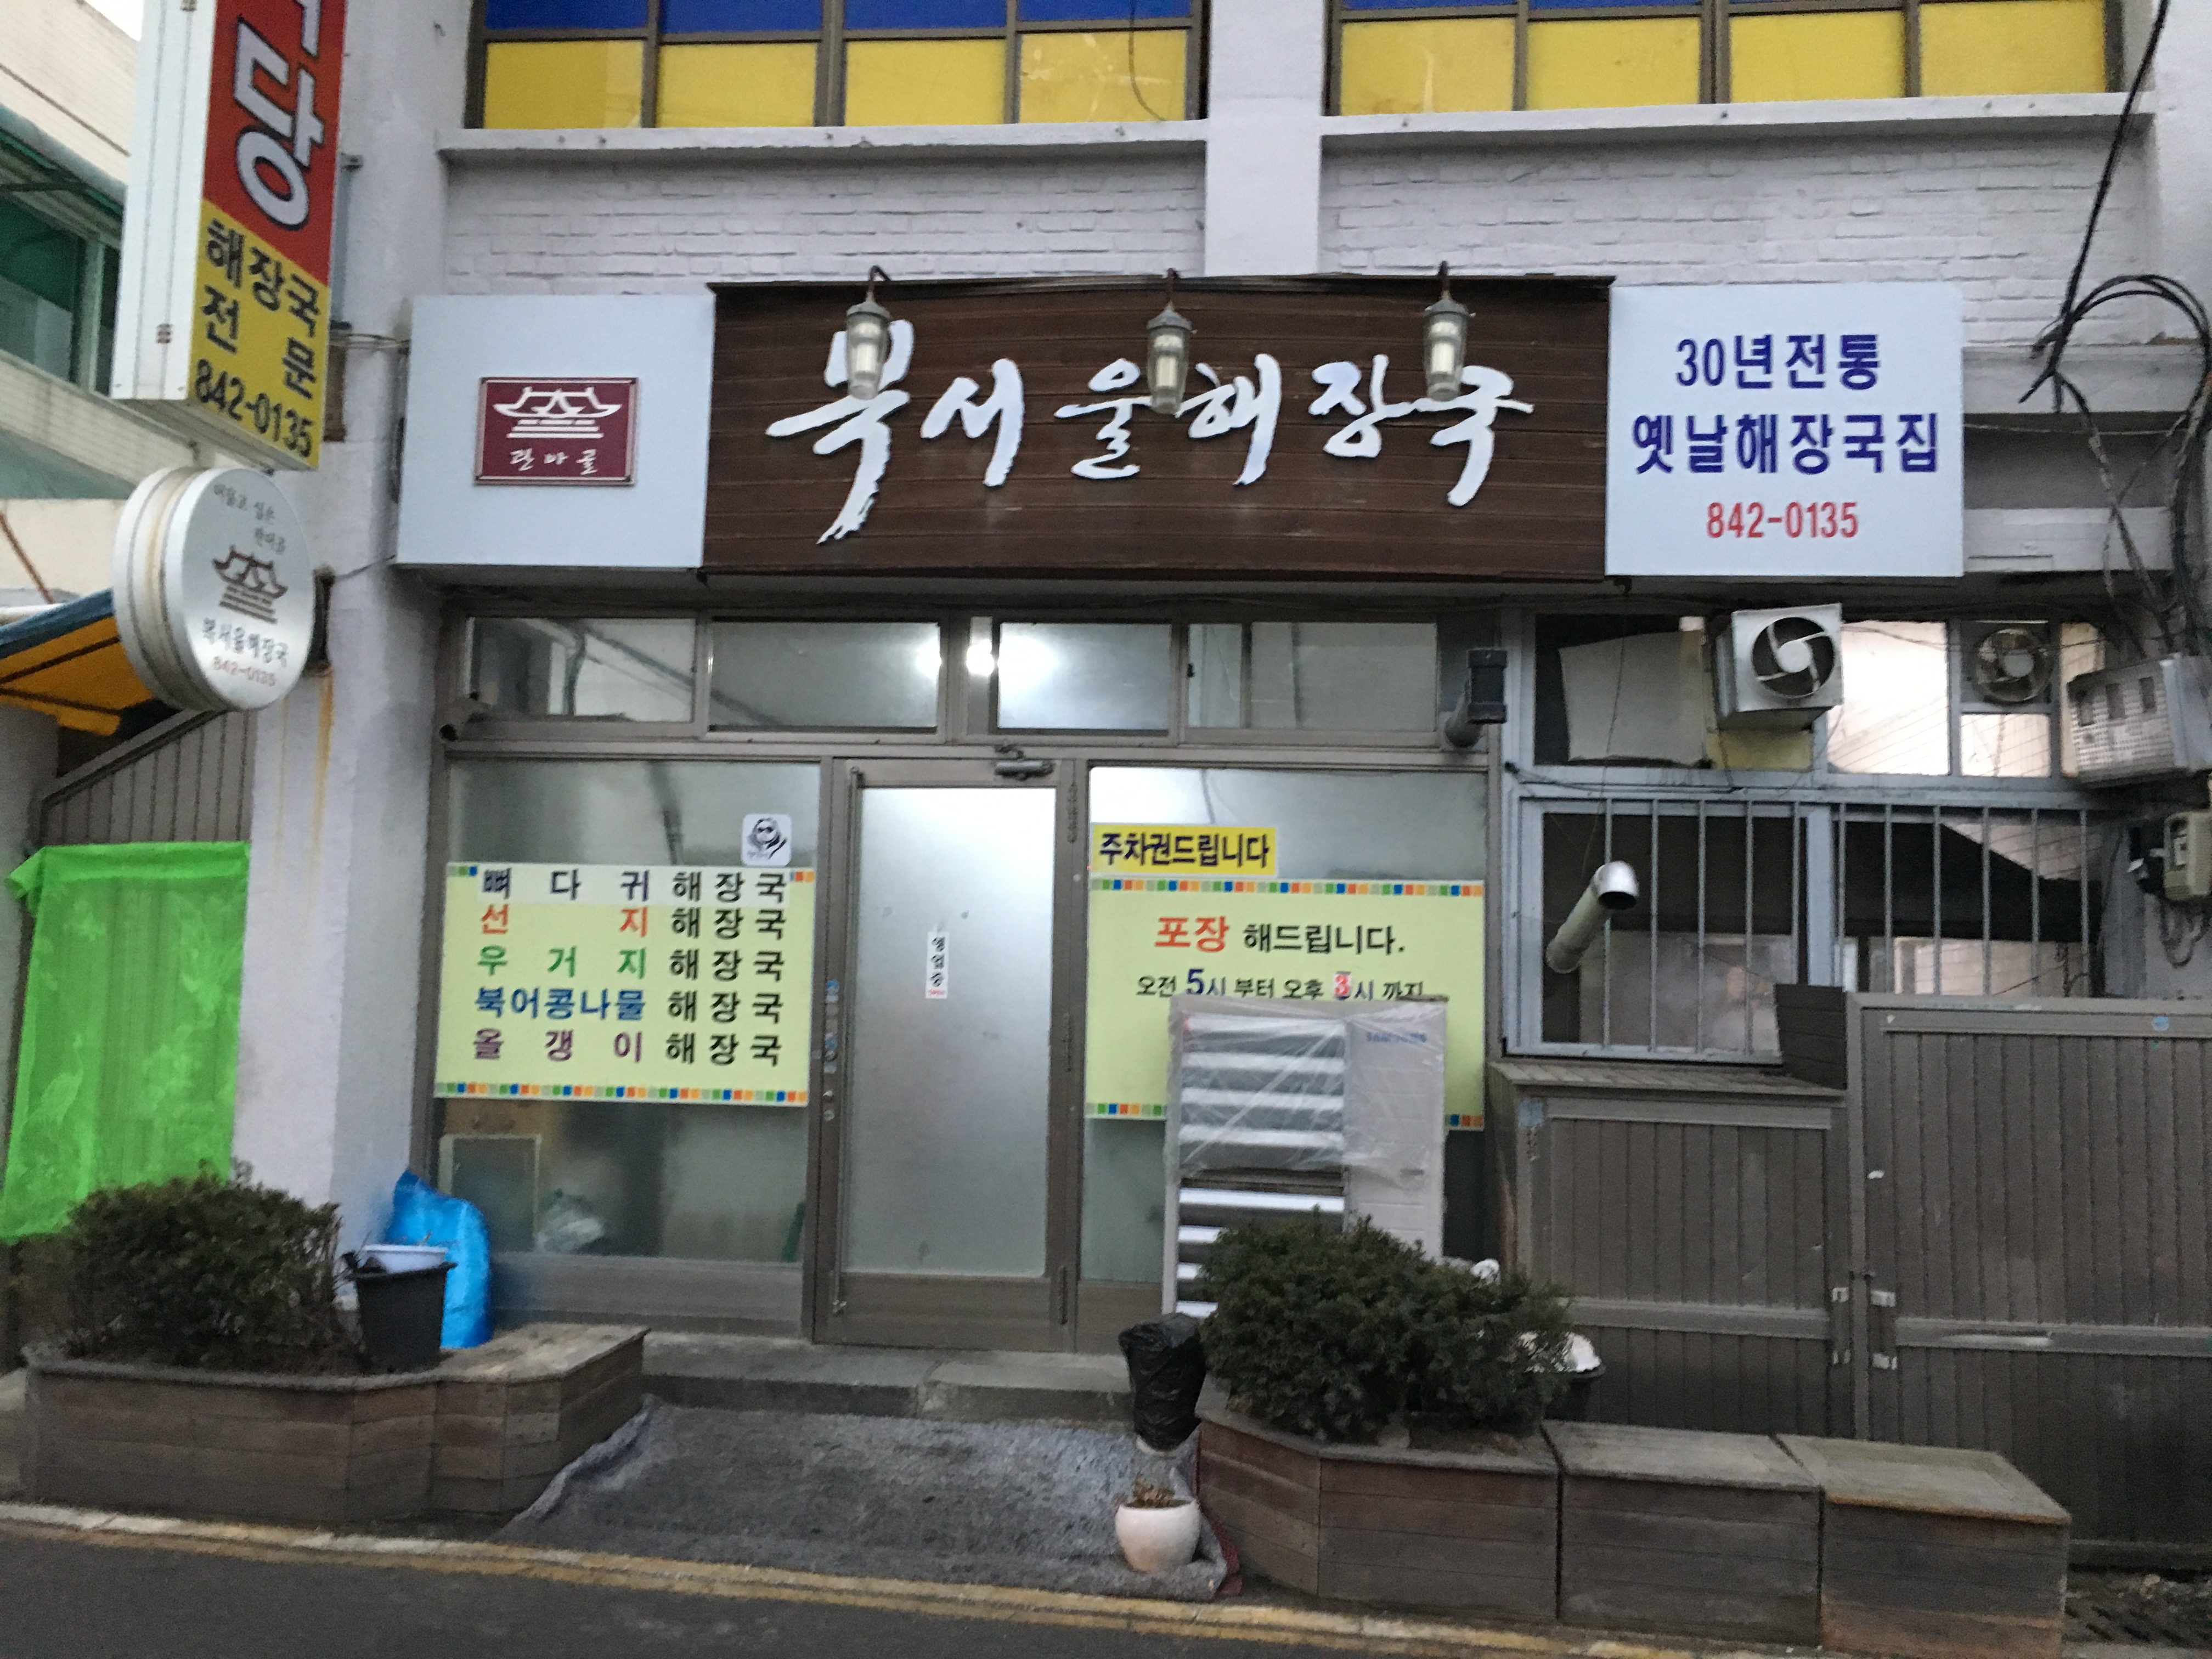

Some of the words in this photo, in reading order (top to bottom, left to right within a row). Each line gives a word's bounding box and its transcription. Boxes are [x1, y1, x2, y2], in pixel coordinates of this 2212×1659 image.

[205, 219, 322, 338] 해장국
[194, 359, 314, 458] 842-0135
[766, 320, 1534, 545] 북서울해장국
[1707, 501, 1859, 539] 842-0135
[1099, 832, 1269, 868] 주차권드립니다
[672, 871, 787, 903] 해장국
[671, 907, 786, 940] 해장국
[1154, 916, 1229, 953] 포장
[1243, 923, 1404, 955] 해드립니다.
[669, 949, 785, 981] 해장국
[1136, 975, 1177, 997] 오전
[1284, 979, 1324, 999] 오후
[475, 987, 645, 1021] 북어콩나물
[667, 991, 783, 1024] 해장국
[665, 1032, 782, 1067] 해장국
[1366, 1031, 1427, 1043] SAMNG
